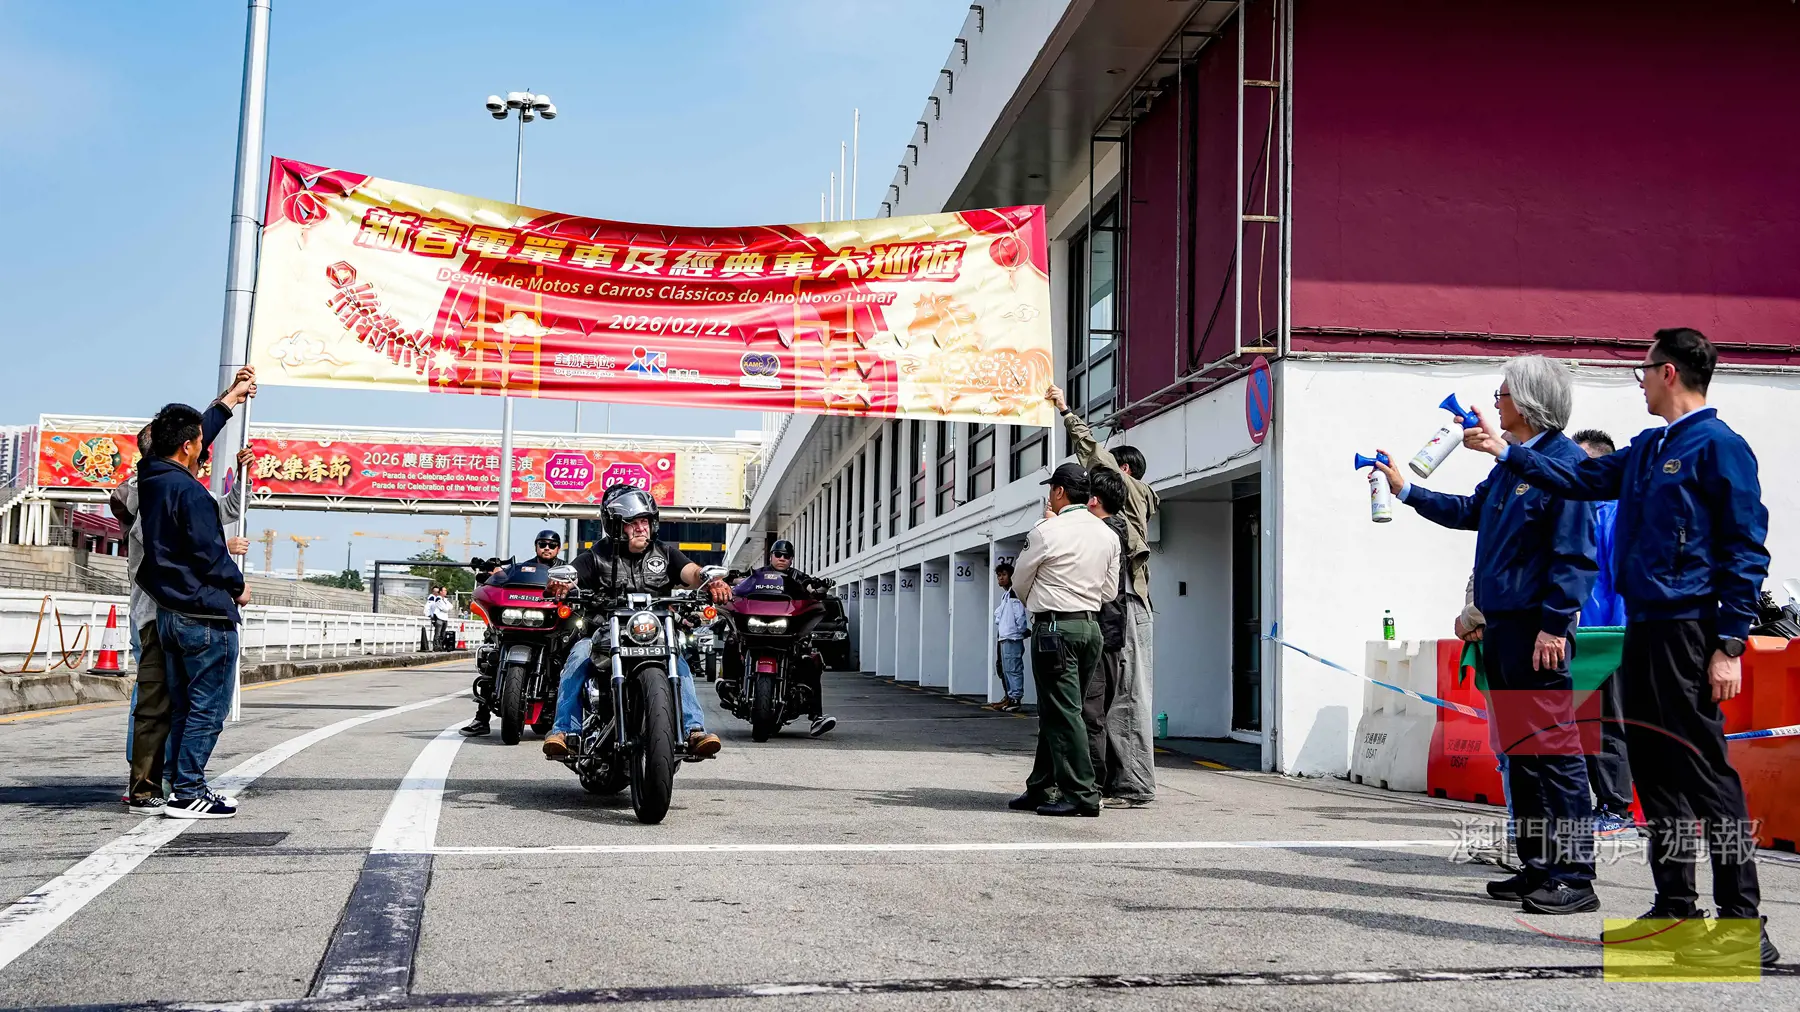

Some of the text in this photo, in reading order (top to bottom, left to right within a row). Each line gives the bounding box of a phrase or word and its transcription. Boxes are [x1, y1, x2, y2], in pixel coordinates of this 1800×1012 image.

[355, 209, 963, 281] 新春電單車及經典車大巡遊
[438, 268, 897, 306] Desfile de Motos e Carros Clássicos do Ano Novo Lunar
[608, 314, 732, 338] 2026/02/22
[363, 452, 399, 465] 2026
[556, 458, 584, 466] 正月初三
[254, 453, 351, 486] 歡樂春節
[550, 467, 589, 479] 02.19
[382, 471, 406, 480] Parada
[407, 472, 416, 480] de
[417, 472, 454, 482] Celebração
[456, 473, 466, 481] do
[480, 474, 489, 482] do
[372, 482, 395, 490] Parade
[397, 482, 406, 490] for
[407, 482, 445, 491] Celebration
[446, 483, 454, 491] of
[466, 484, 481, 492] Year
[482, 484, 490, 492] of
[606, 476, 647, 489] 0228
[956, 565, 972, 577] 36
[901, 578, 914, 589] 34
[925, 573, 940, 584] 35
[865, 587, 876, 597] 32
[881, 583, 893, 593] 33
[839, 593, 848, 601] 30
[620, 646, 666, 656] MI-91-91
[1365, 748, 1378, 759] DSAT
[1450, 755, 1469, 768] DSAT
